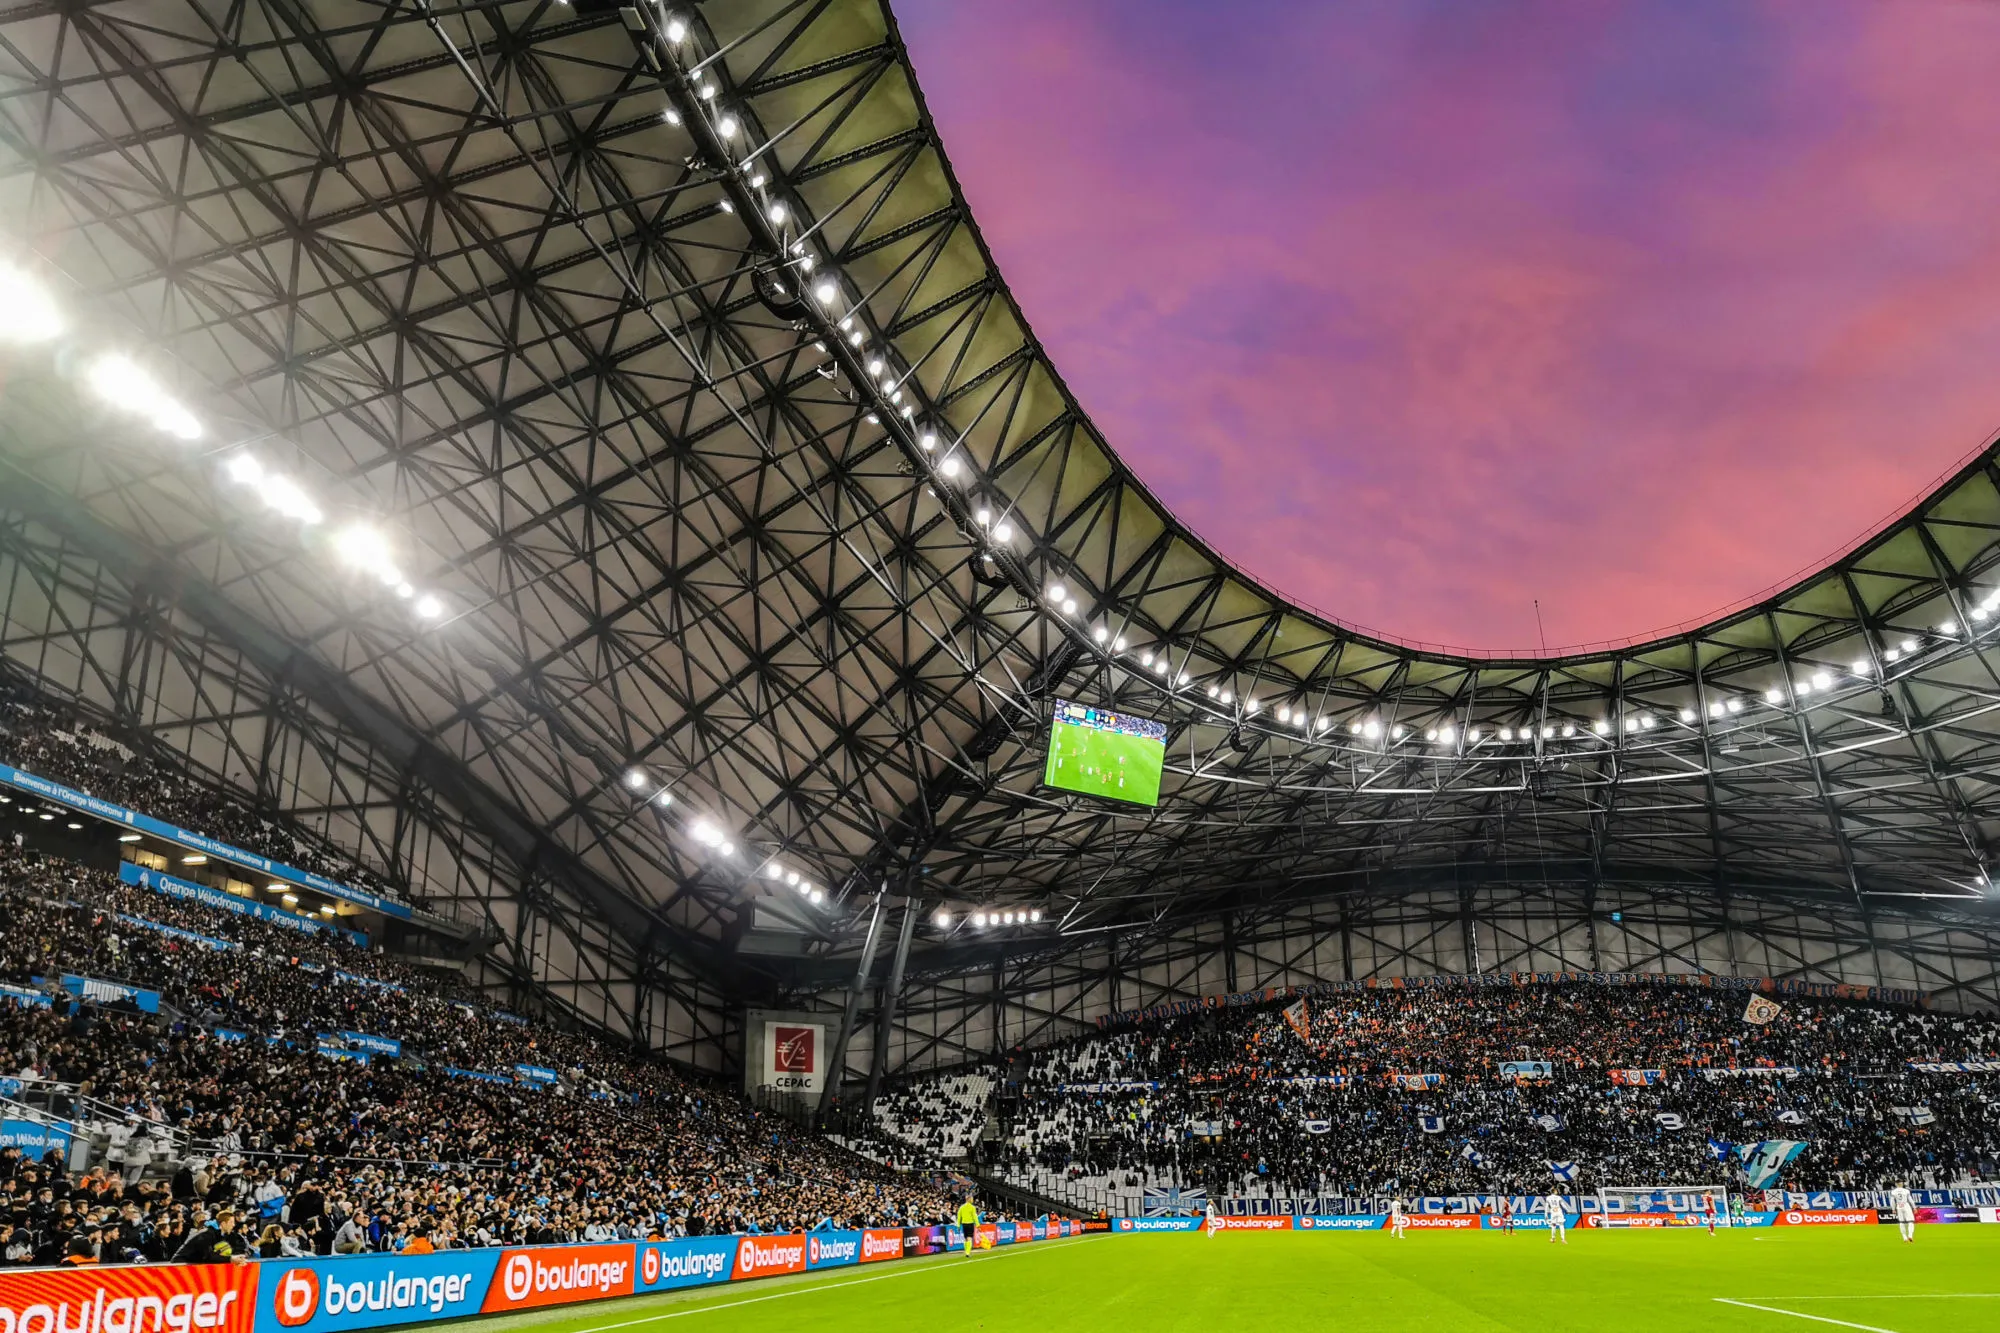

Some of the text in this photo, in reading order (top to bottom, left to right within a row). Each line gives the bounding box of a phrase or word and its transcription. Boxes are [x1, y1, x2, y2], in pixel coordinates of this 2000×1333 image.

[13, 771, 52, 793] Bienvenue
[58, 788, 87, 805] l'Orange
[88, 797, 123, 818] Vélodrome
[160, 877, 245, 913] Orange Vélodrome
[270, 910, 300, 929] Orange
[1402, 973, 1511, 987] WINNERS
[1536, 972, 1678, 985] MARSEILLE
[1710, 976, 1761, 991] 1987
[776, 1078, 811, 1088] CEPAC
[1423, 1195, 1626, 1215] COMMANDO
[1928, 1189, 1943, 1204] les
[1134, 1218, 1191, 1230] boulanger
[1227, 1218, 1285, 1229] boulanger
[1316, 1217, 1374, 1228] boulanger
[1412, 1216, 1472, 1228] boulanger
[1513, 1216, 1566, 1228] oulang
[1804, 1213, 1867, 1223] boulanger
[755, 1244, 803, 1269] boulanger
[820, 1239, 857, 1261] boulanger
[662, 1250, 726, 1279] boulanger
[535, 1257, 628, 1293] boulanger
[325, 1270, 472, 1315] boulanger
